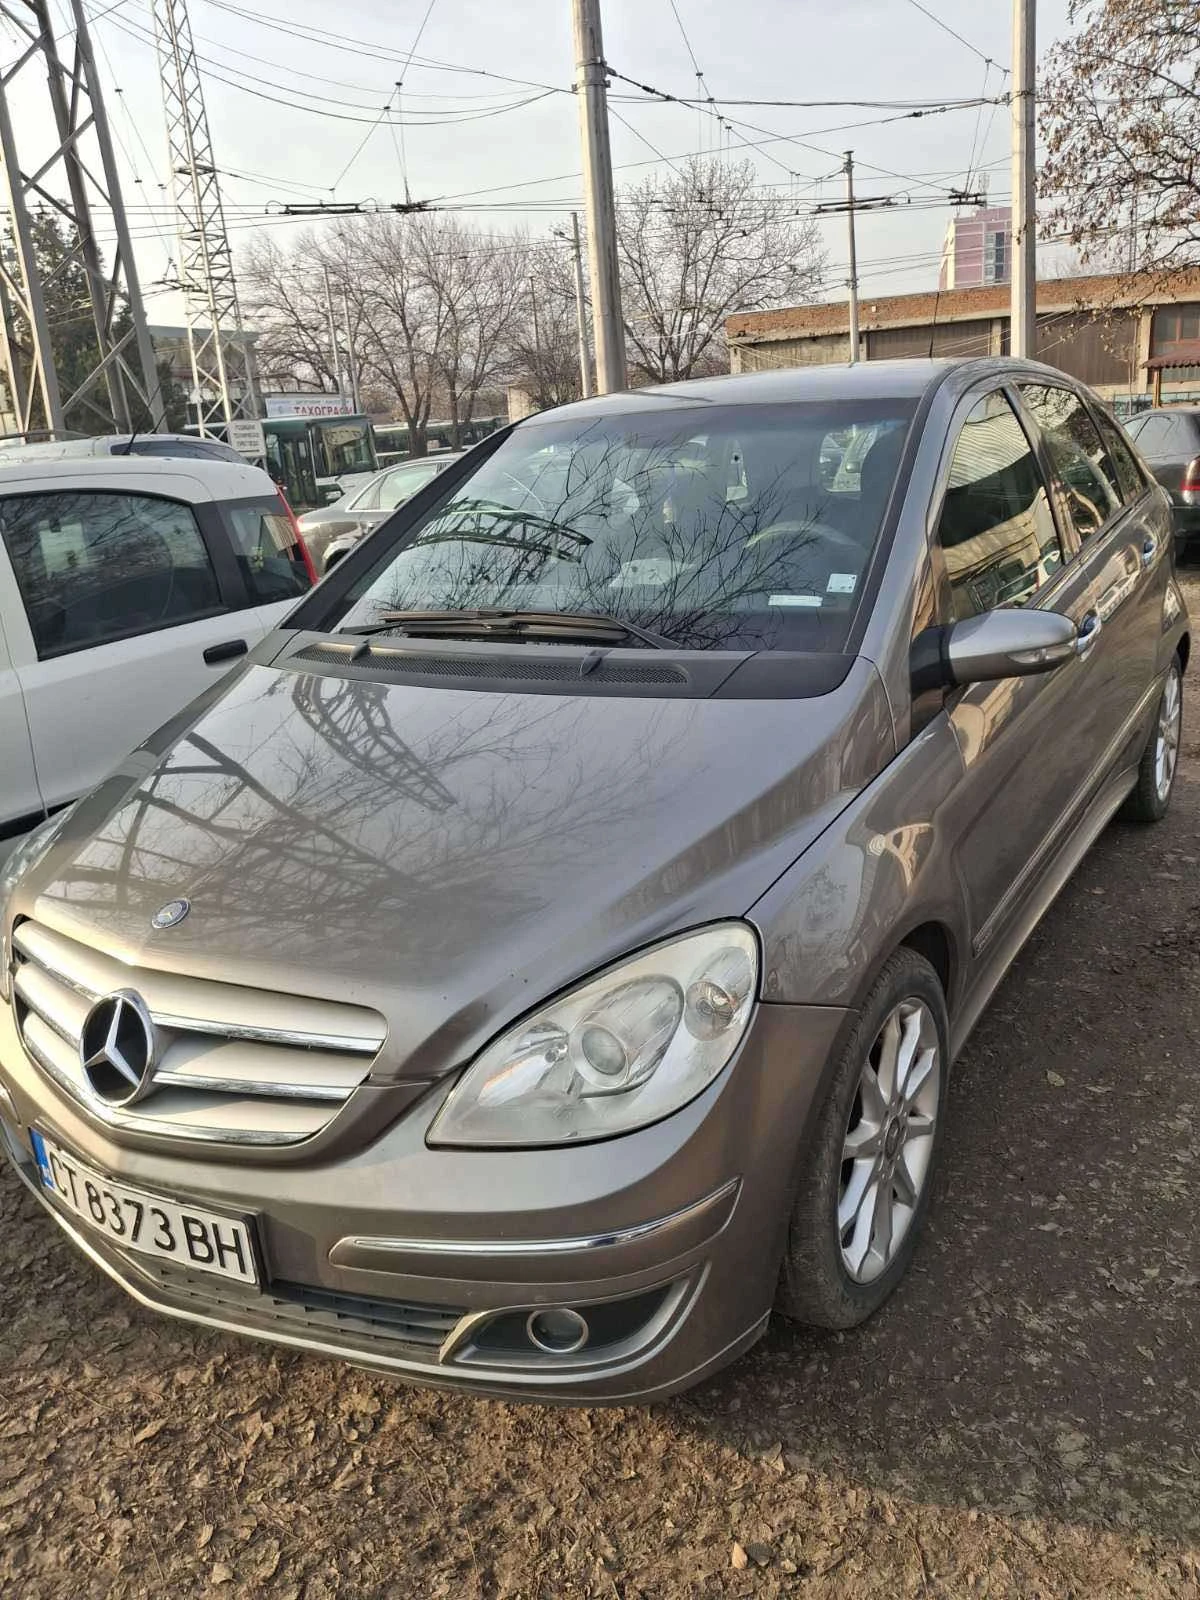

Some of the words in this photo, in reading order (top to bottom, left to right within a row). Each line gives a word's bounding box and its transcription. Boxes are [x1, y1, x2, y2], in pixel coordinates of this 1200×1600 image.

[49, 1151, 80, 1209] CT
[85, 1180, 176, 1251] 8373
[181, 1215, 247, 1275] BH
